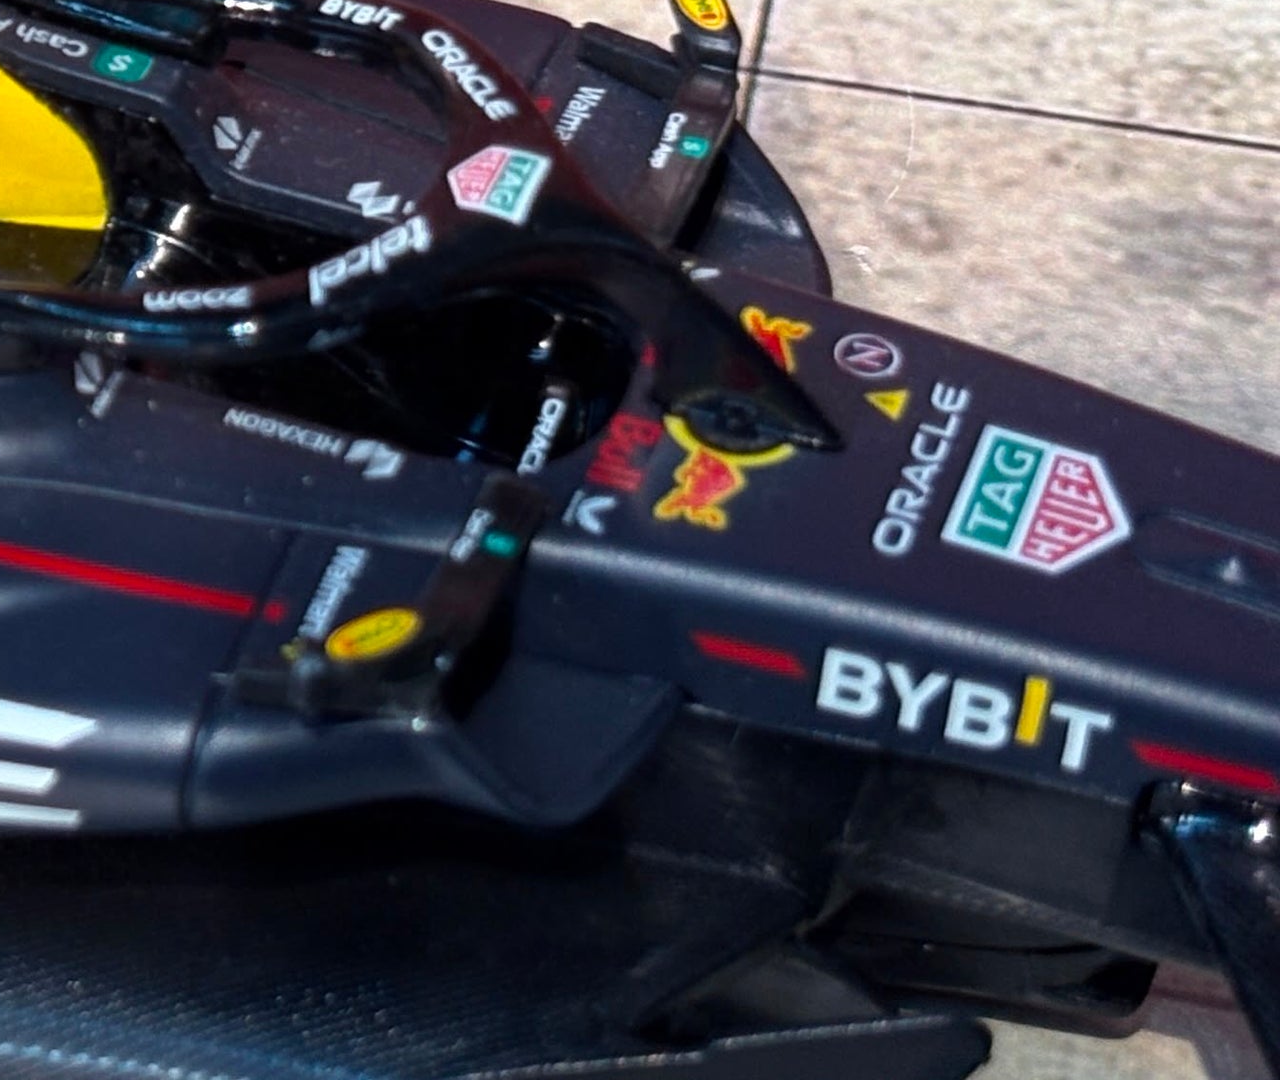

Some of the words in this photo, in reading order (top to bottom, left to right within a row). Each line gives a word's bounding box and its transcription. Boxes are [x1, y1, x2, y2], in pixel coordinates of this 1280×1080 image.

[15, 23, 89, 58] Cash
[421, 29, 518, 121] ORACLE
[554, 85, 608, 146] Walma
[488, 155, 532, 208] TAG
[142, 285, 252, 312] zoom
[308, 214, 433, 307] telcel
[222, 407, 344, 457] HEXAGON
[585, 412, 664, 493] Bull
[872, 383, 971, 557] ORACLE
[964, 442, 1038, 540] TAG
[1022, 453, 1115, 565] HEUER
[816, 647, 1115, 771] BYBIT
